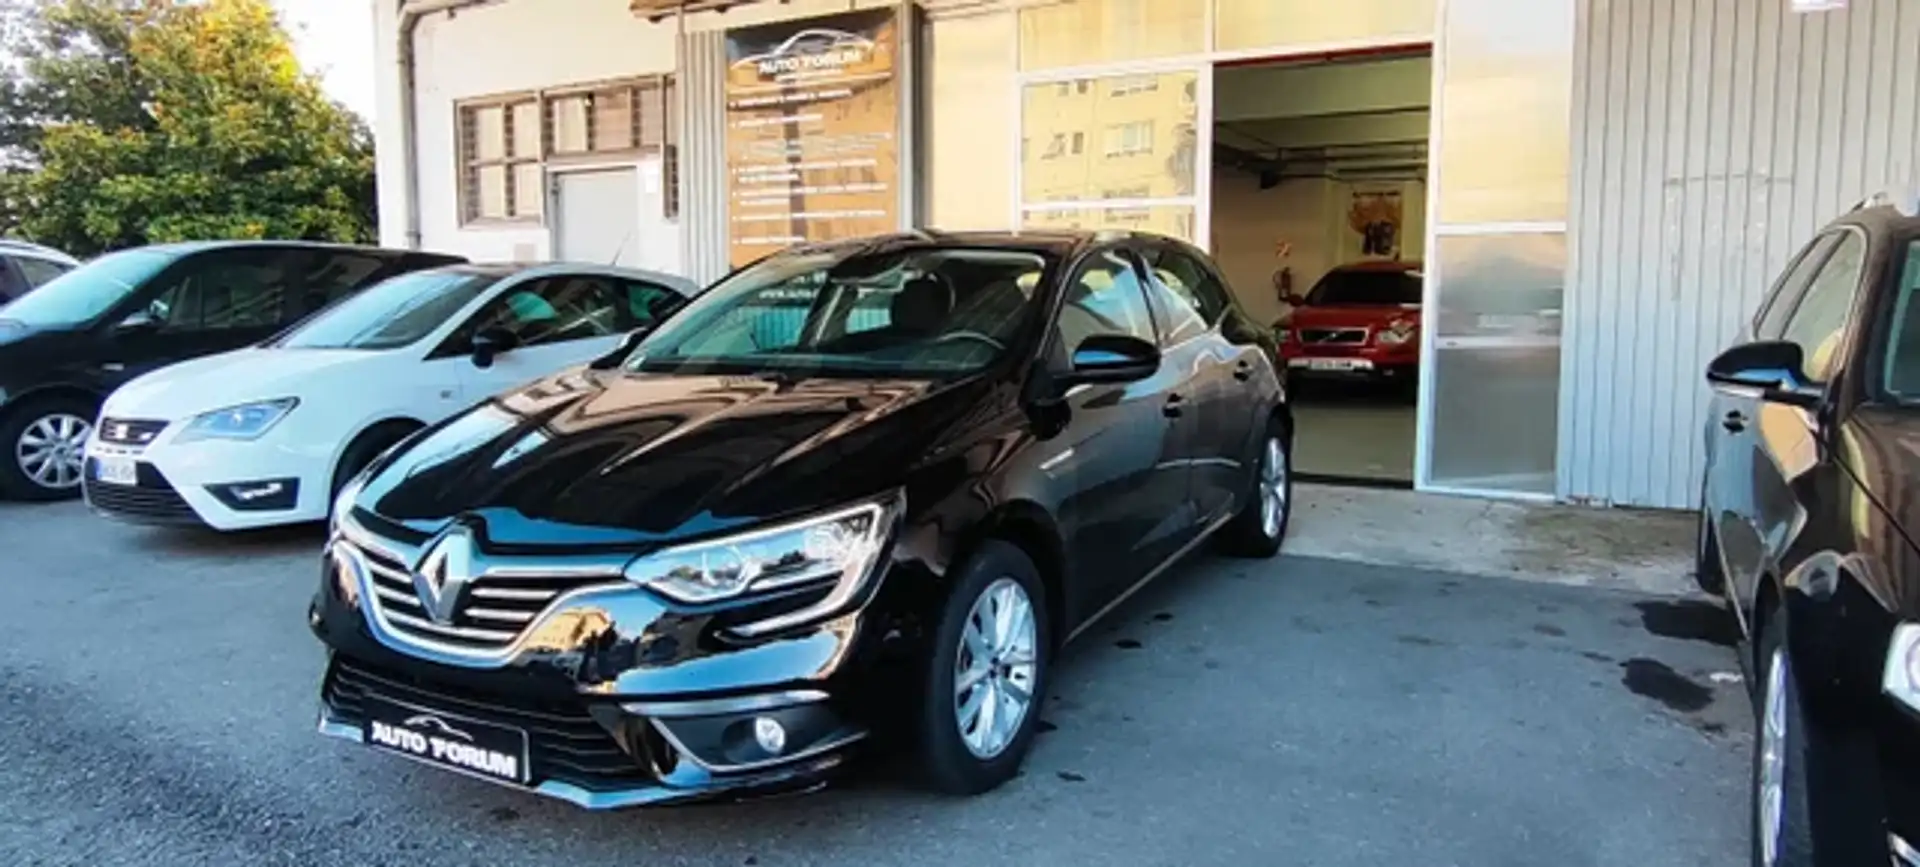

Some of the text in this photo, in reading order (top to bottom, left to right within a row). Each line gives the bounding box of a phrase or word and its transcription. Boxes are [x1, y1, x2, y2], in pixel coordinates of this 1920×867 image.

[759, 50, 863, 74] AUTO FORUM
[371, 720, 517, 778] AUTO FORUM
